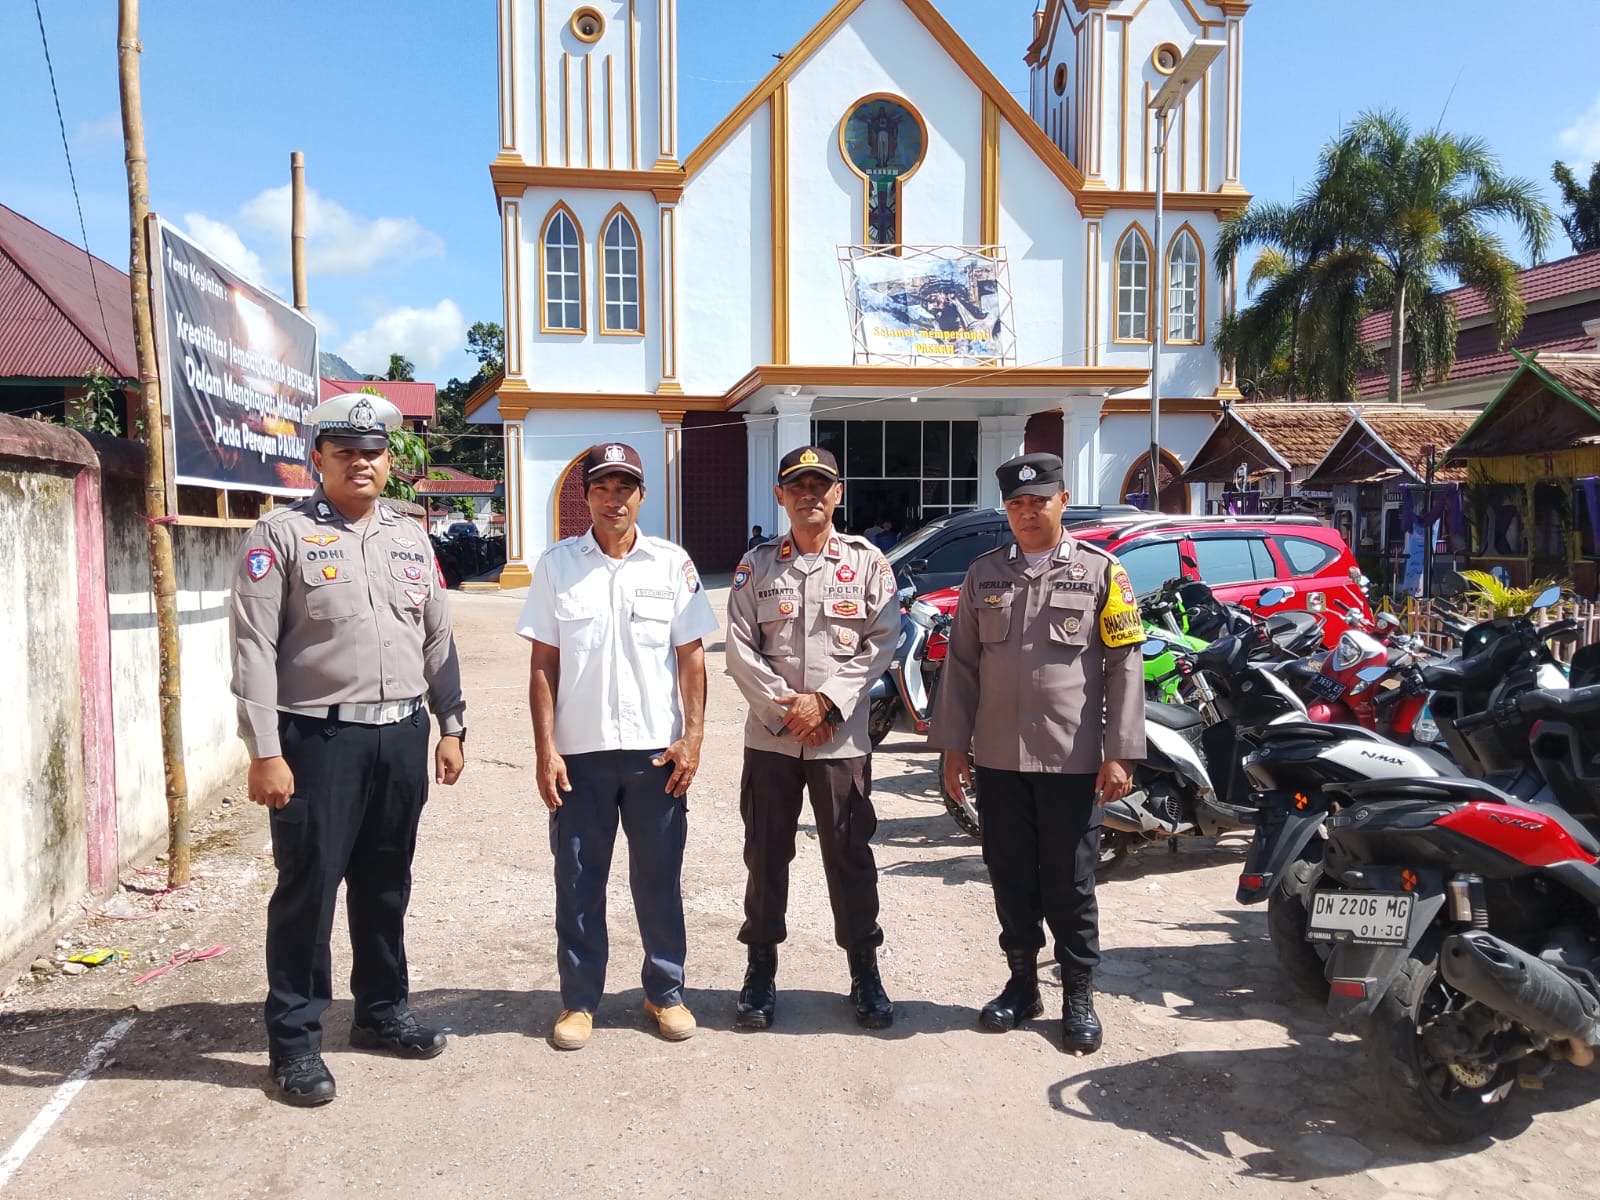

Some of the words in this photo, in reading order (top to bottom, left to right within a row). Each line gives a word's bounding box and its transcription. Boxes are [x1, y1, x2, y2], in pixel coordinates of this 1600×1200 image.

[190, 262, 224, 300] Kegiatan
[185, 356, 223, 398] Dalam
[223, 372, 277, 417] Menghayati
[214, 415, 241, 449] Pada
[306, 549, 345, 561] ODHI
[390, 551, 425, 563] POLRI
[828, 586, 863, 595] POLRI
[1055, 581, 1094, 592] POLRI
[1315, 897, 1334, 915] DN
[1338, 897, 1378, 917] 2206
